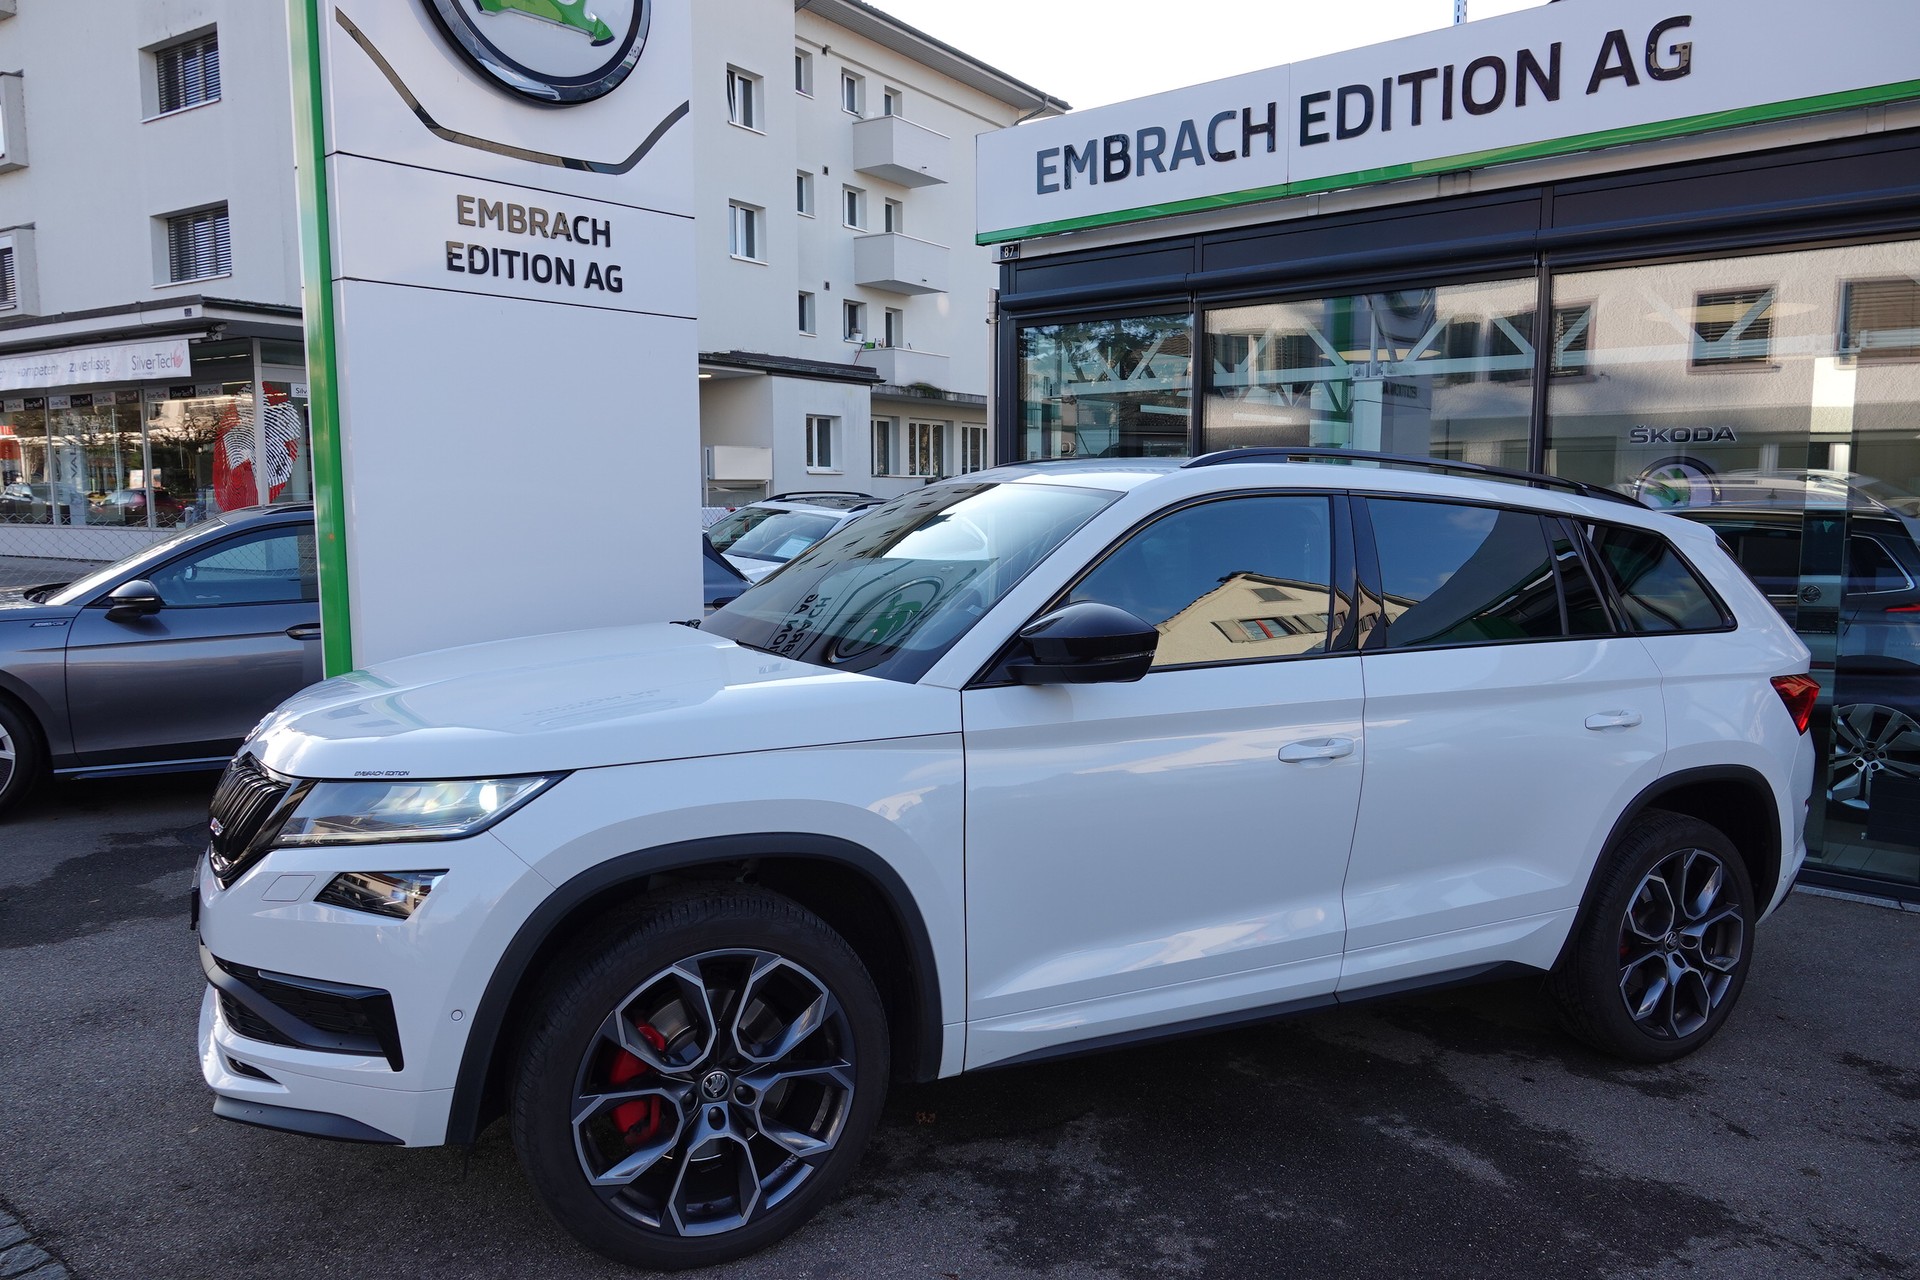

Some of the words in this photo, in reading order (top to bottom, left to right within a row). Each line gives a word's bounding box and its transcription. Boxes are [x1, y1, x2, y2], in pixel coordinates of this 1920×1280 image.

[1037, 102, 1276, 195] EMBRACH
[1300, 41, 1562, 147] EDITION
[1586, 15, 1692, 95] AG
[457, 194, 611, 248] EMBRACH
[446, 240, 575, 287] EDITION
[584, 262, 622, 293] AG
[1004, 246, 1014, 258] 87
[1629, 425, 1737, 444] ŠKODA
